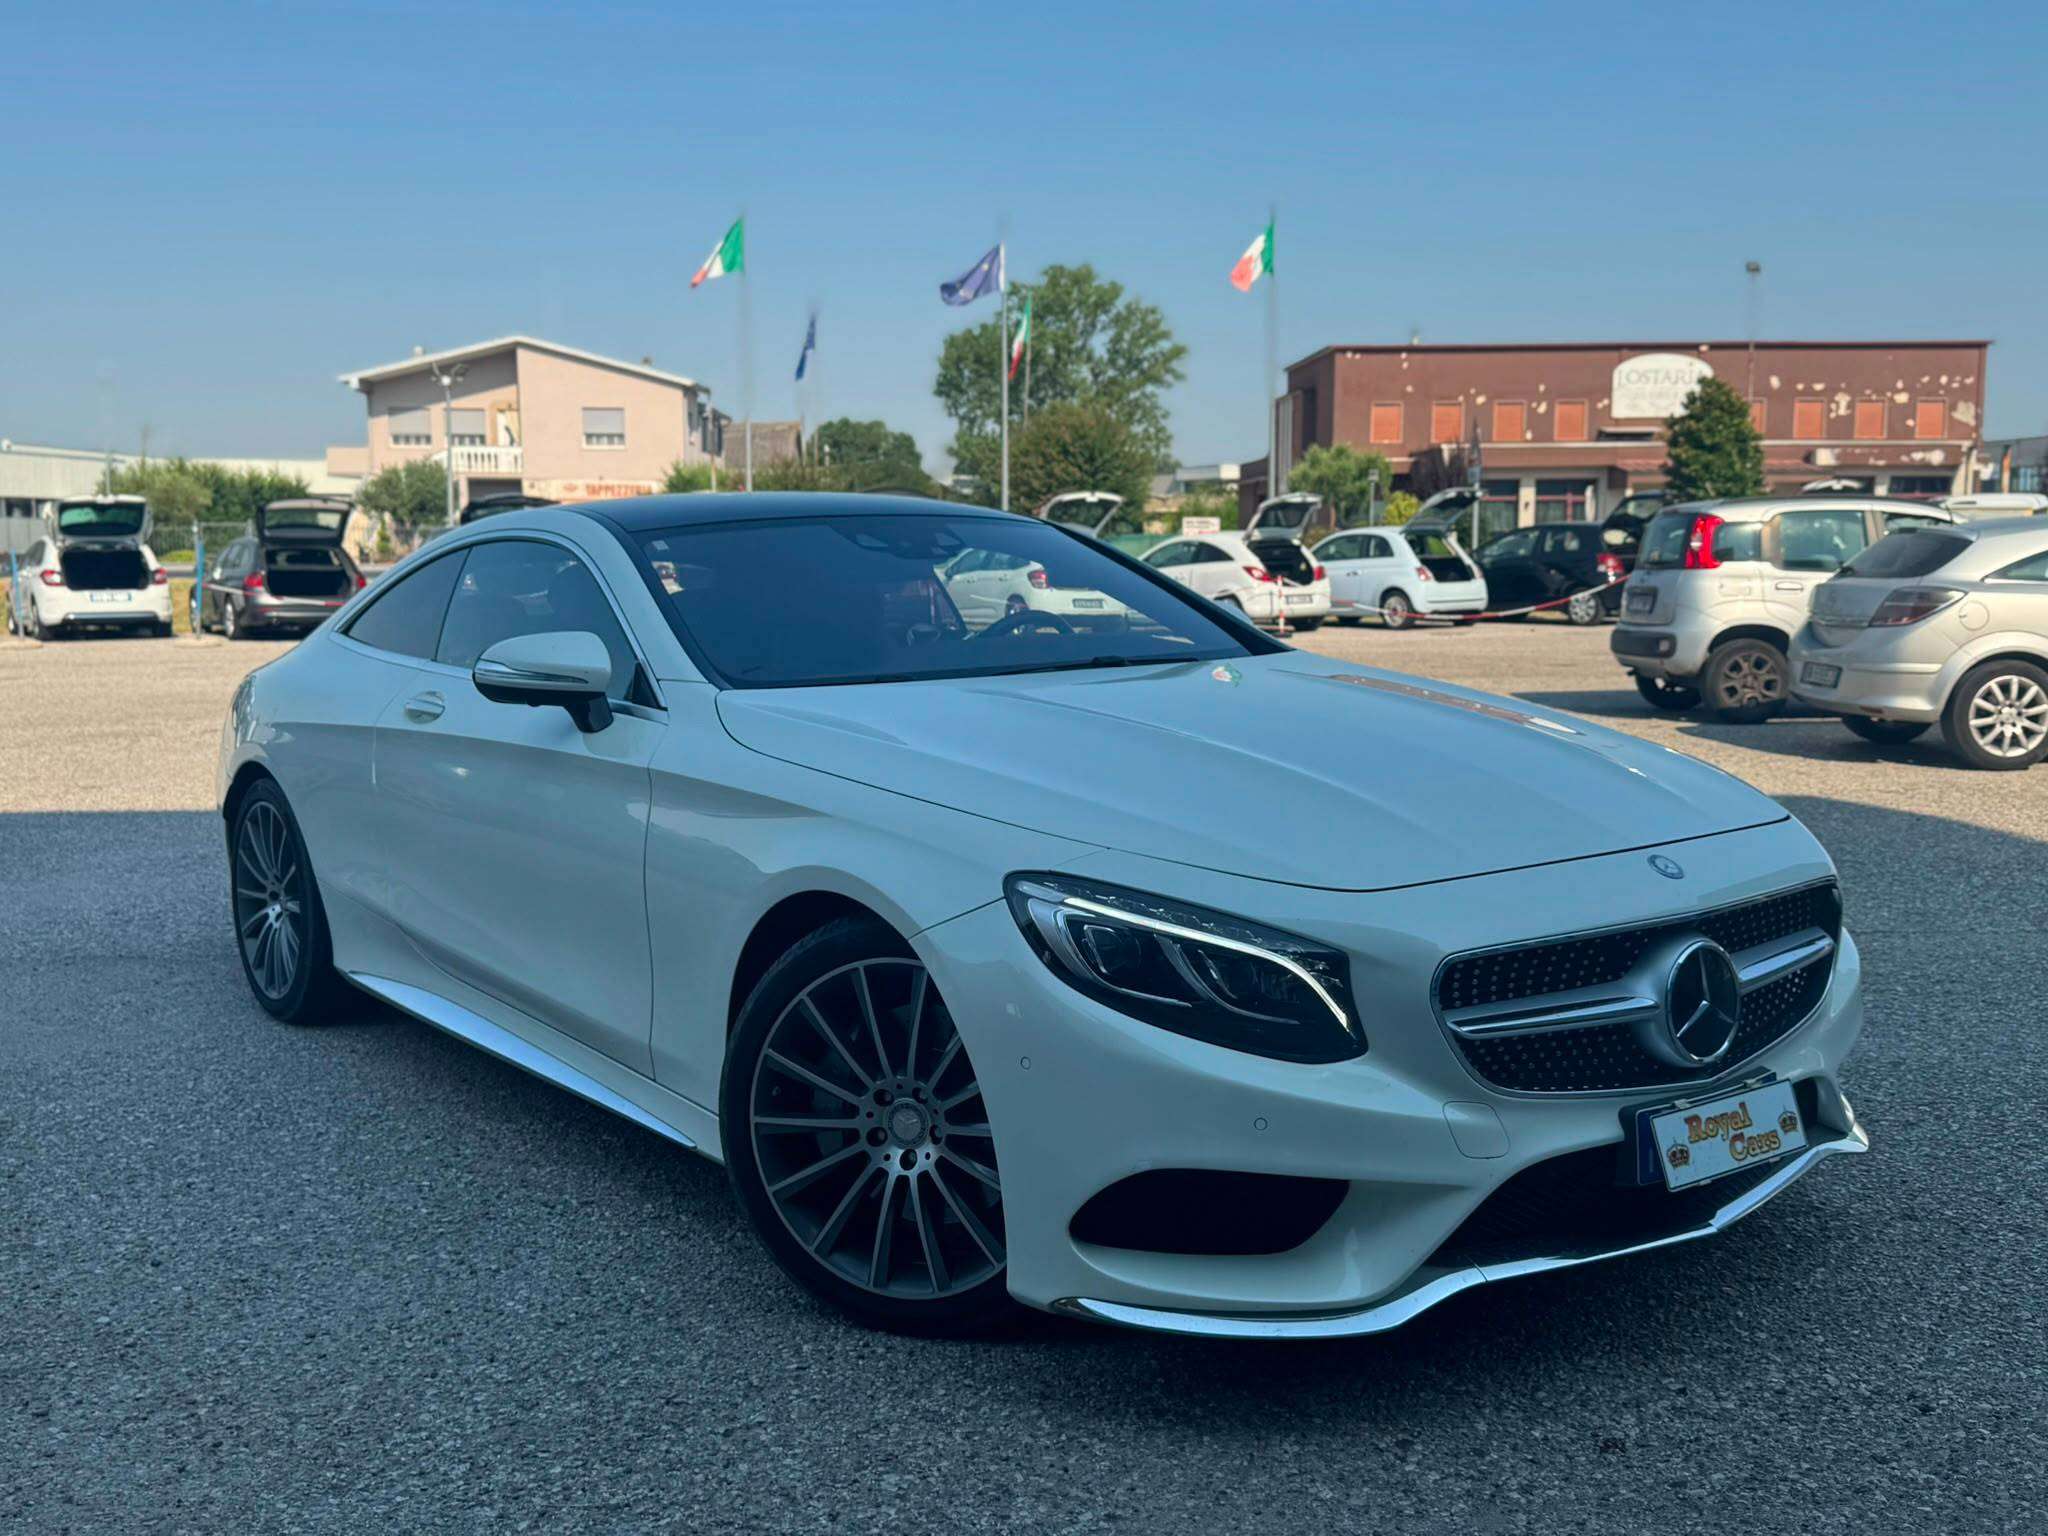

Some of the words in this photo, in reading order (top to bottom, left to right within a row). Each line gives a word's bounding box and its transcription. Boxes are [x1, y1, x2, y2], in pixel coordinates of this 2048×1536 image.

[1617, 368, 1704, 387] LOSTARI
[1684, 1101, 1753, 1144] Royal
[1729, 1130, 1781, 1161] Cars
